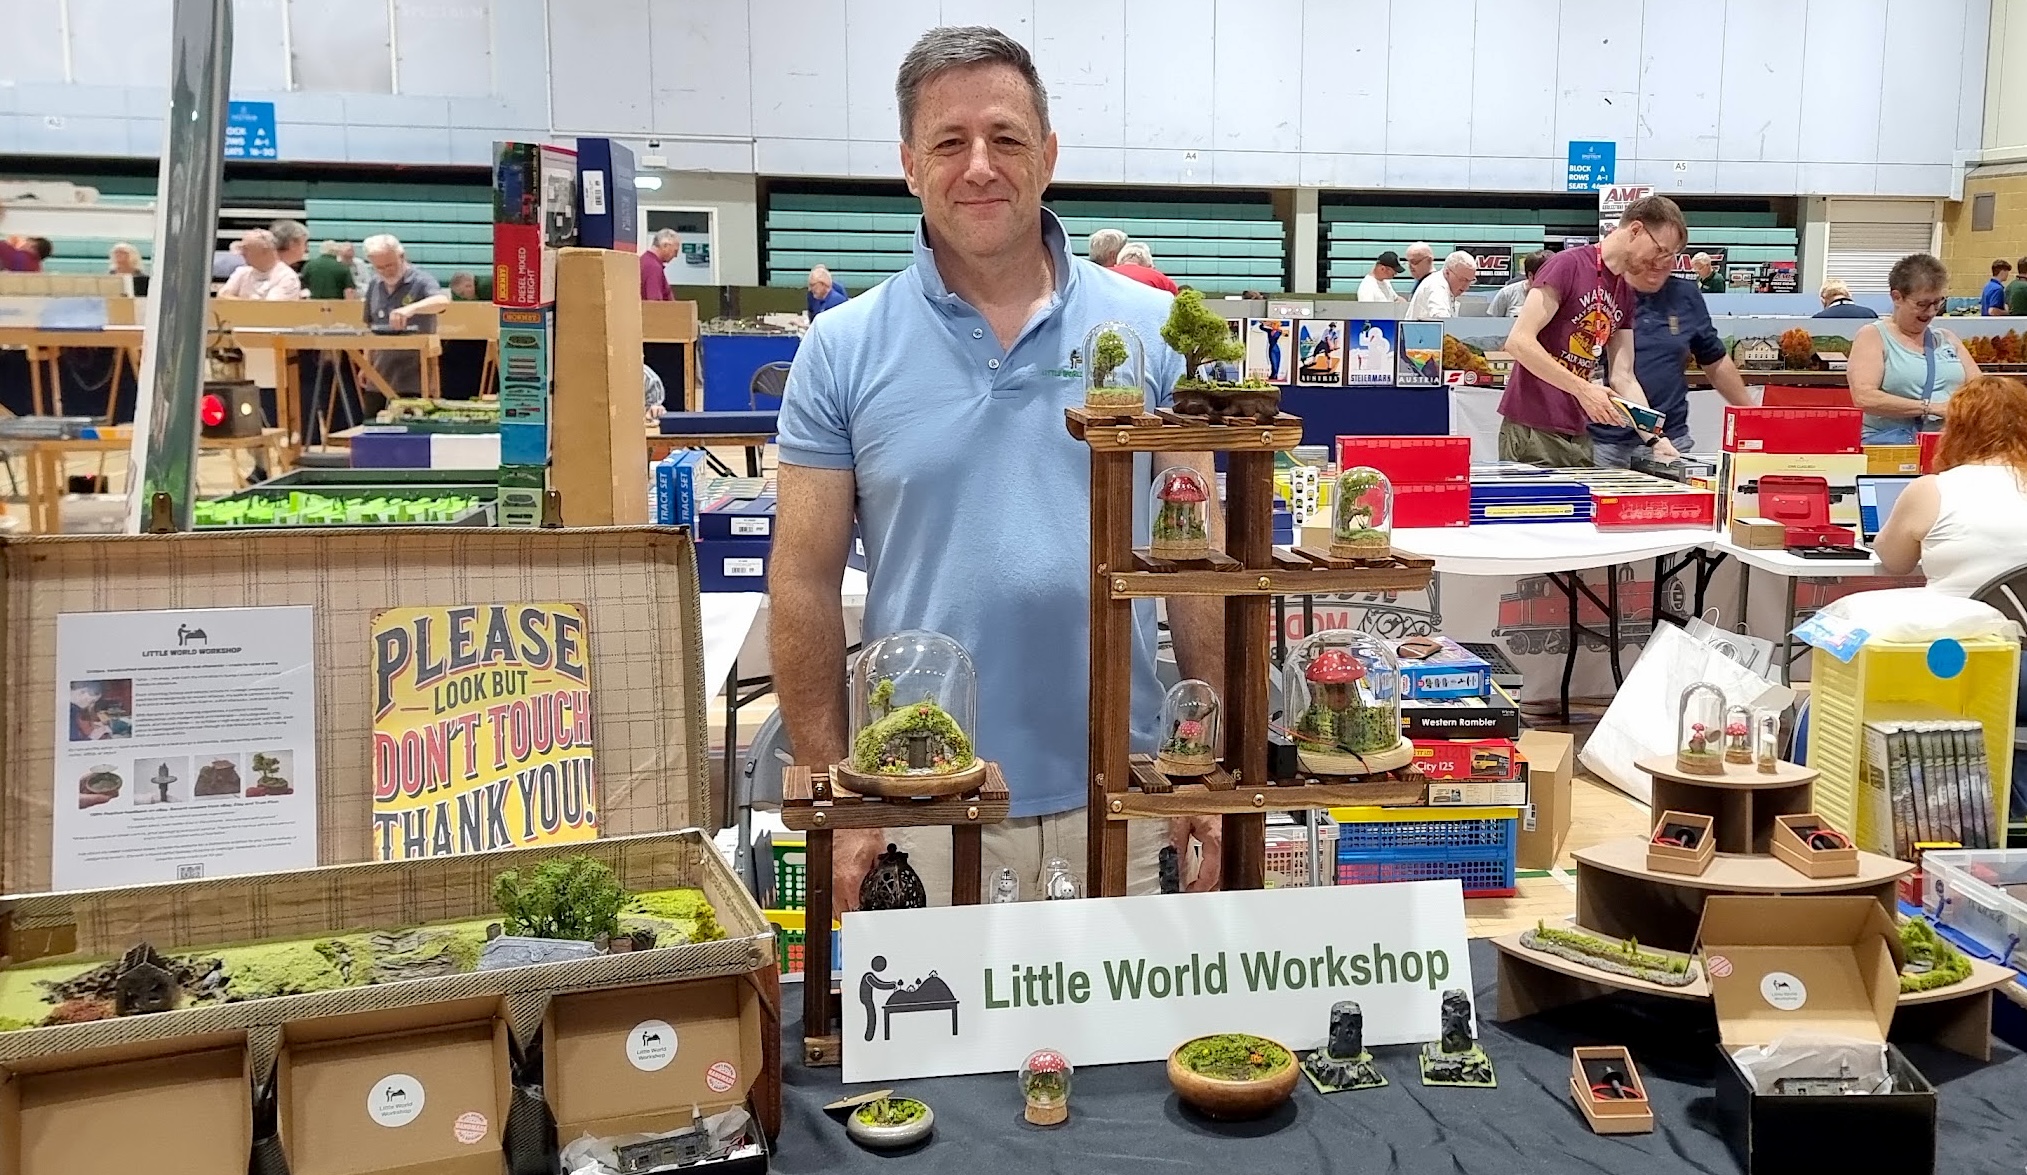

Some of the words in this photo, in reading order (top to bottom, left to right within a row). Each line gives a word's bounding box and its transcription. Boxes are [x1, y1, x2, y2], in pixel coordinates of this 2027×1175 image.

[1185, 152, 1197, 160] A4
[1675, 162, 1687, 170] A5
[1568, 182, 1588, 190] SEATS
[518, 247, 526, 274] MIXED
[1476, 255, 1511, 270] MC
[499, 267, 507, 299] HORNBY
[518, 277, 526, 303] DIESEL
[527, 269, 535, 303] FREIGHT
[1571, 311, 1587, 325] MAY
[1560, 350, 1578, 363] TALK
[1350, 374, 1392, 382] STEIERMARK
[1398, 376, 1440, 384] AUSTRIA
[660, 473, 668, 489] SET
[680, 472, 689, 488] SET
[660, 492, 669, 522] TRACK
[682, 491, 690, 521] TRACK
[199, 647, 242, 655] WORKSHOP
[375, 605, 588, 723] PLEASE
[434, 672, 487, 716] LOOK
[493, 670, 529, 698] BUT
[1421, 718, 1458, 727] Western
[1459, 717, 1497, 727] Rambler
[375, 712, 482, 801] DON'T
[487, 690, 593, 770] TOUCH
[1416, 761, 1437, 774] City
[1439, 761, 1455, 771] 125
[375, 779, 514, 860] THANK
[517, 757, 597, 841] YOU!
[984, 961, 1091, 1010] Little
[1103, 951, 1229, 1001] World
[1240, 942, 1451, 992] Workshop
[638, 1053, 666, 1061] Workshop
[379, 1104, 395, 1112] Little
[381, 1109, 412, 1117] Workshop
